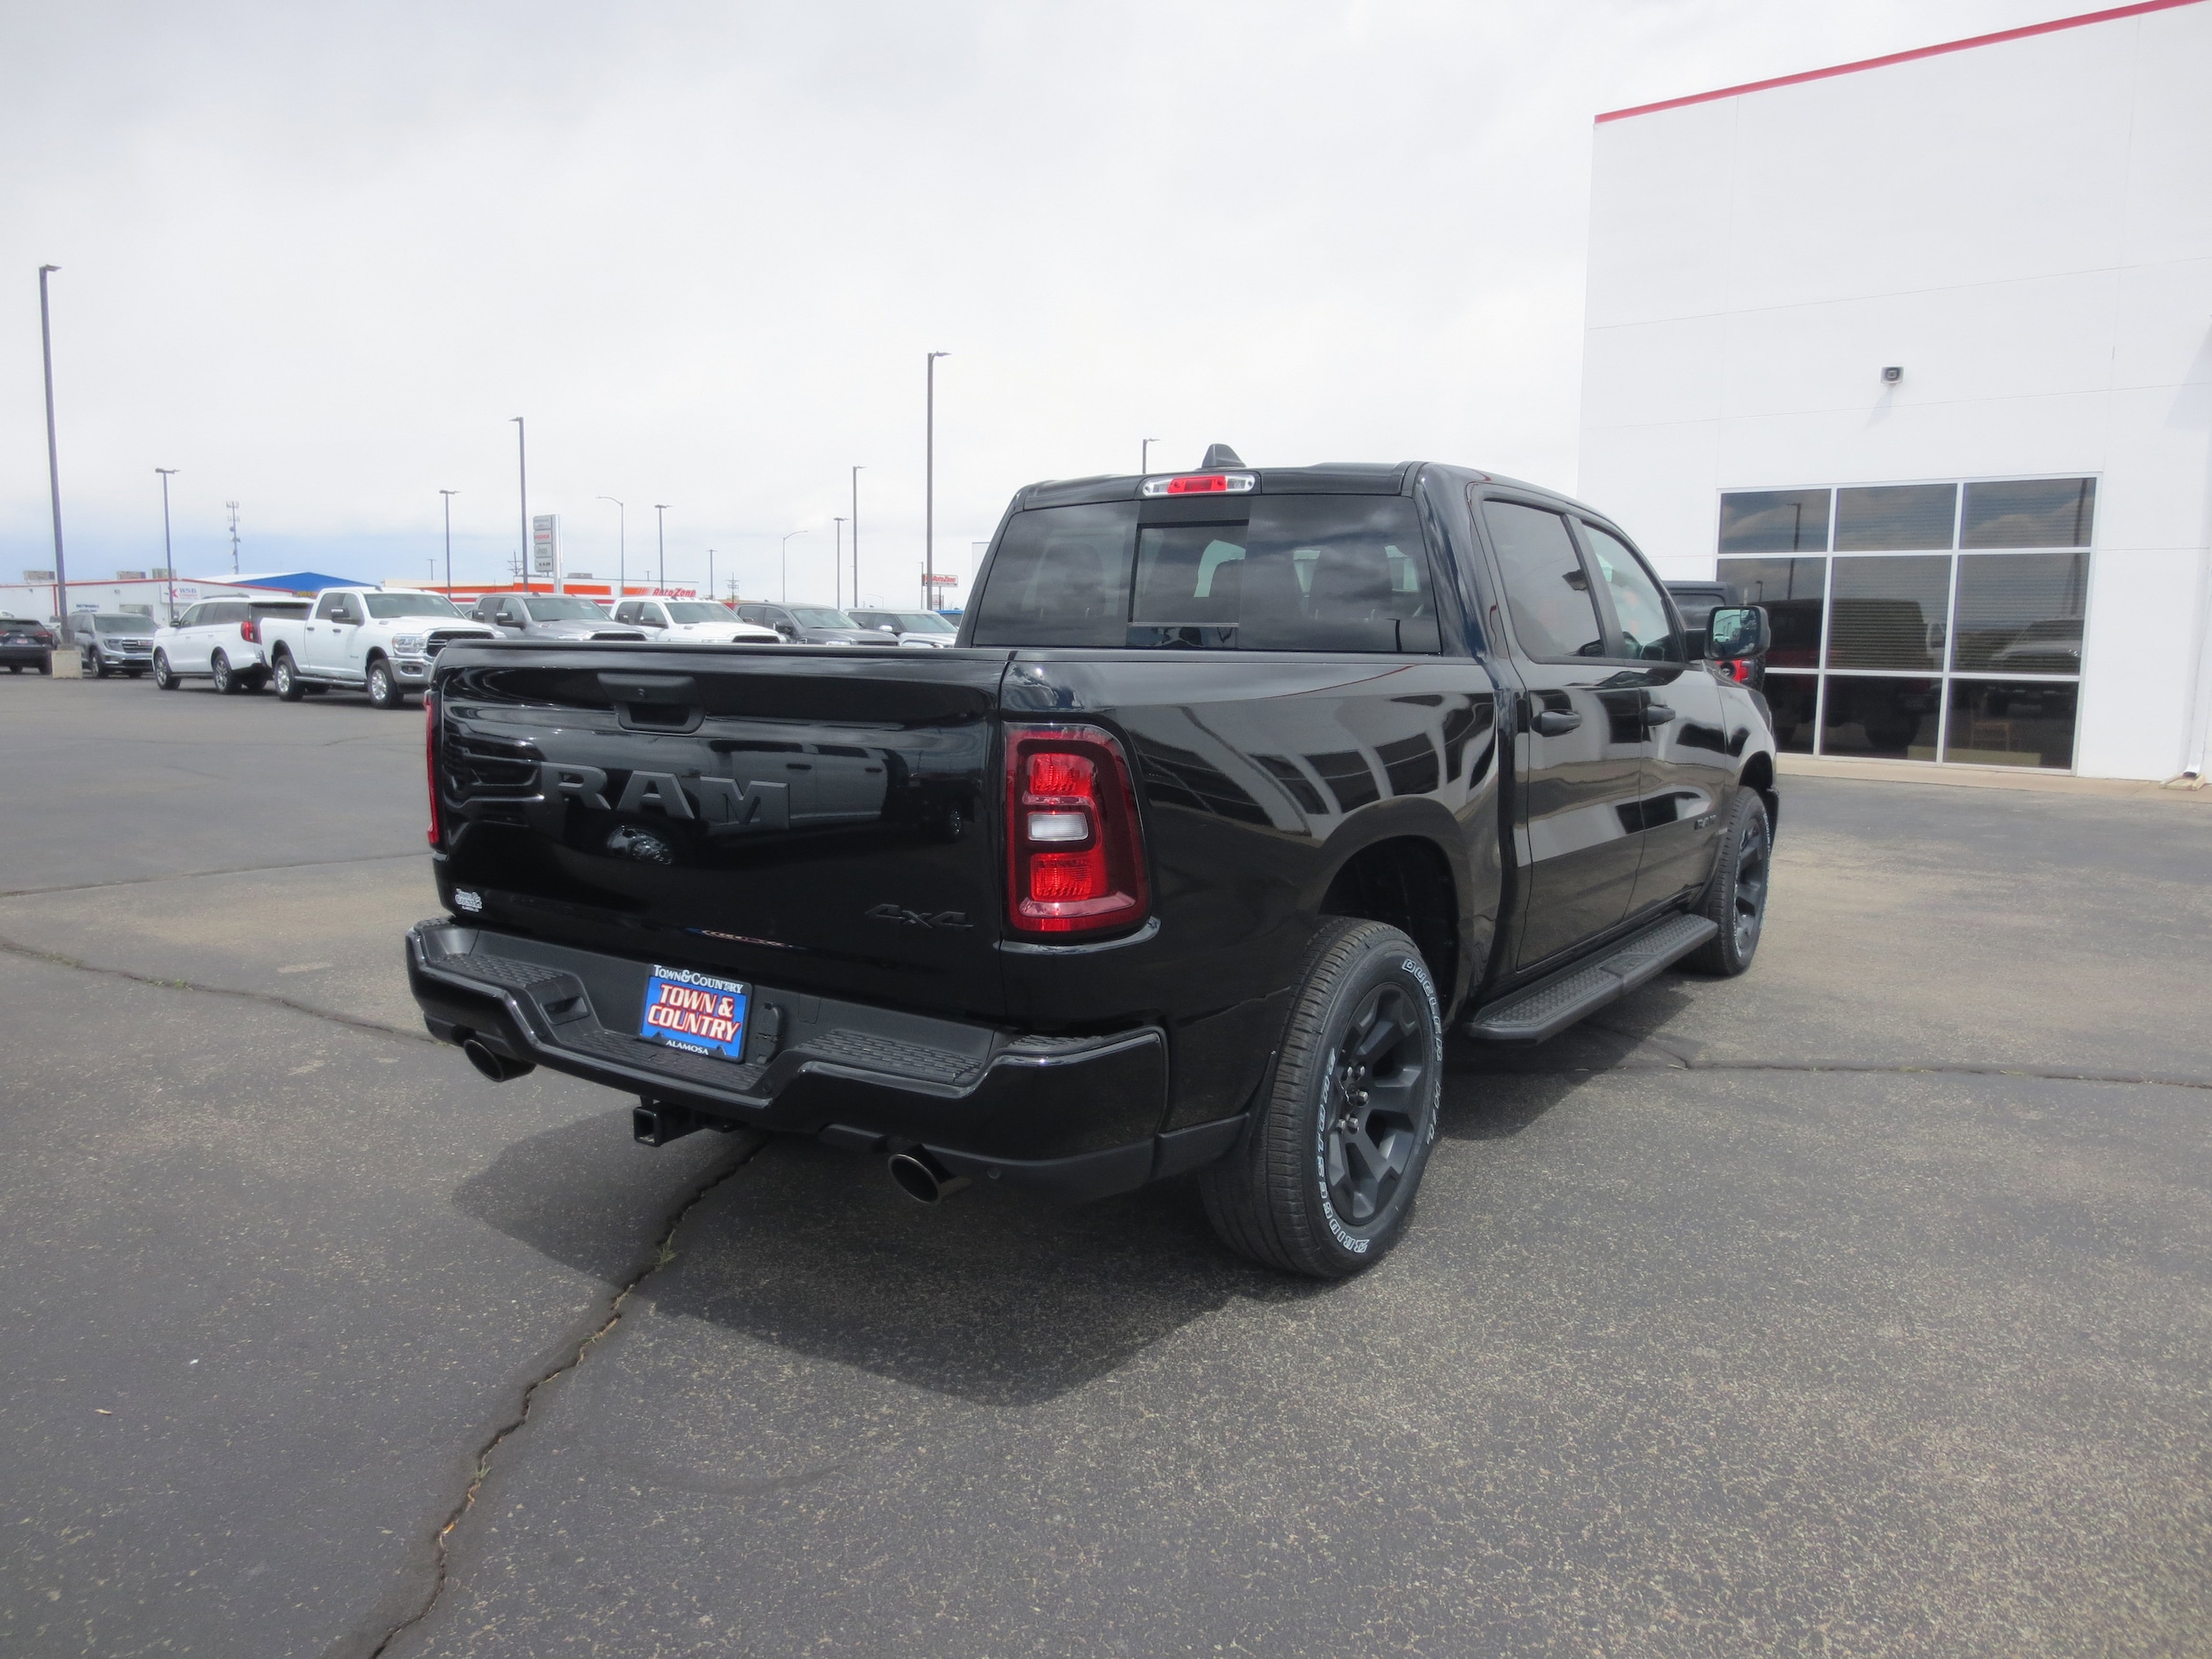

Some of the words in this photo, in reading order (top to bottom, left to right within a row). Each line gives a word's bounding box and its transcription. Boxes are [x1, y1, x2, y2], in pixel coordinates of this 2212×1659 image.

[652, 588, 697, 598] AutoZone
[541, 761, 790, 830] RAM
[659, 983, 718, 1015] TOWN
[718, 995, 734, 1018] &
[1402, 958, 1443, 1062] DUELER
[647, 1004, 741, 1042] COUNTRY
[665, 1039, 710, 1056] ALAMOSA
[1316, 1048, 1370, 1254] BRIDGESTONE
